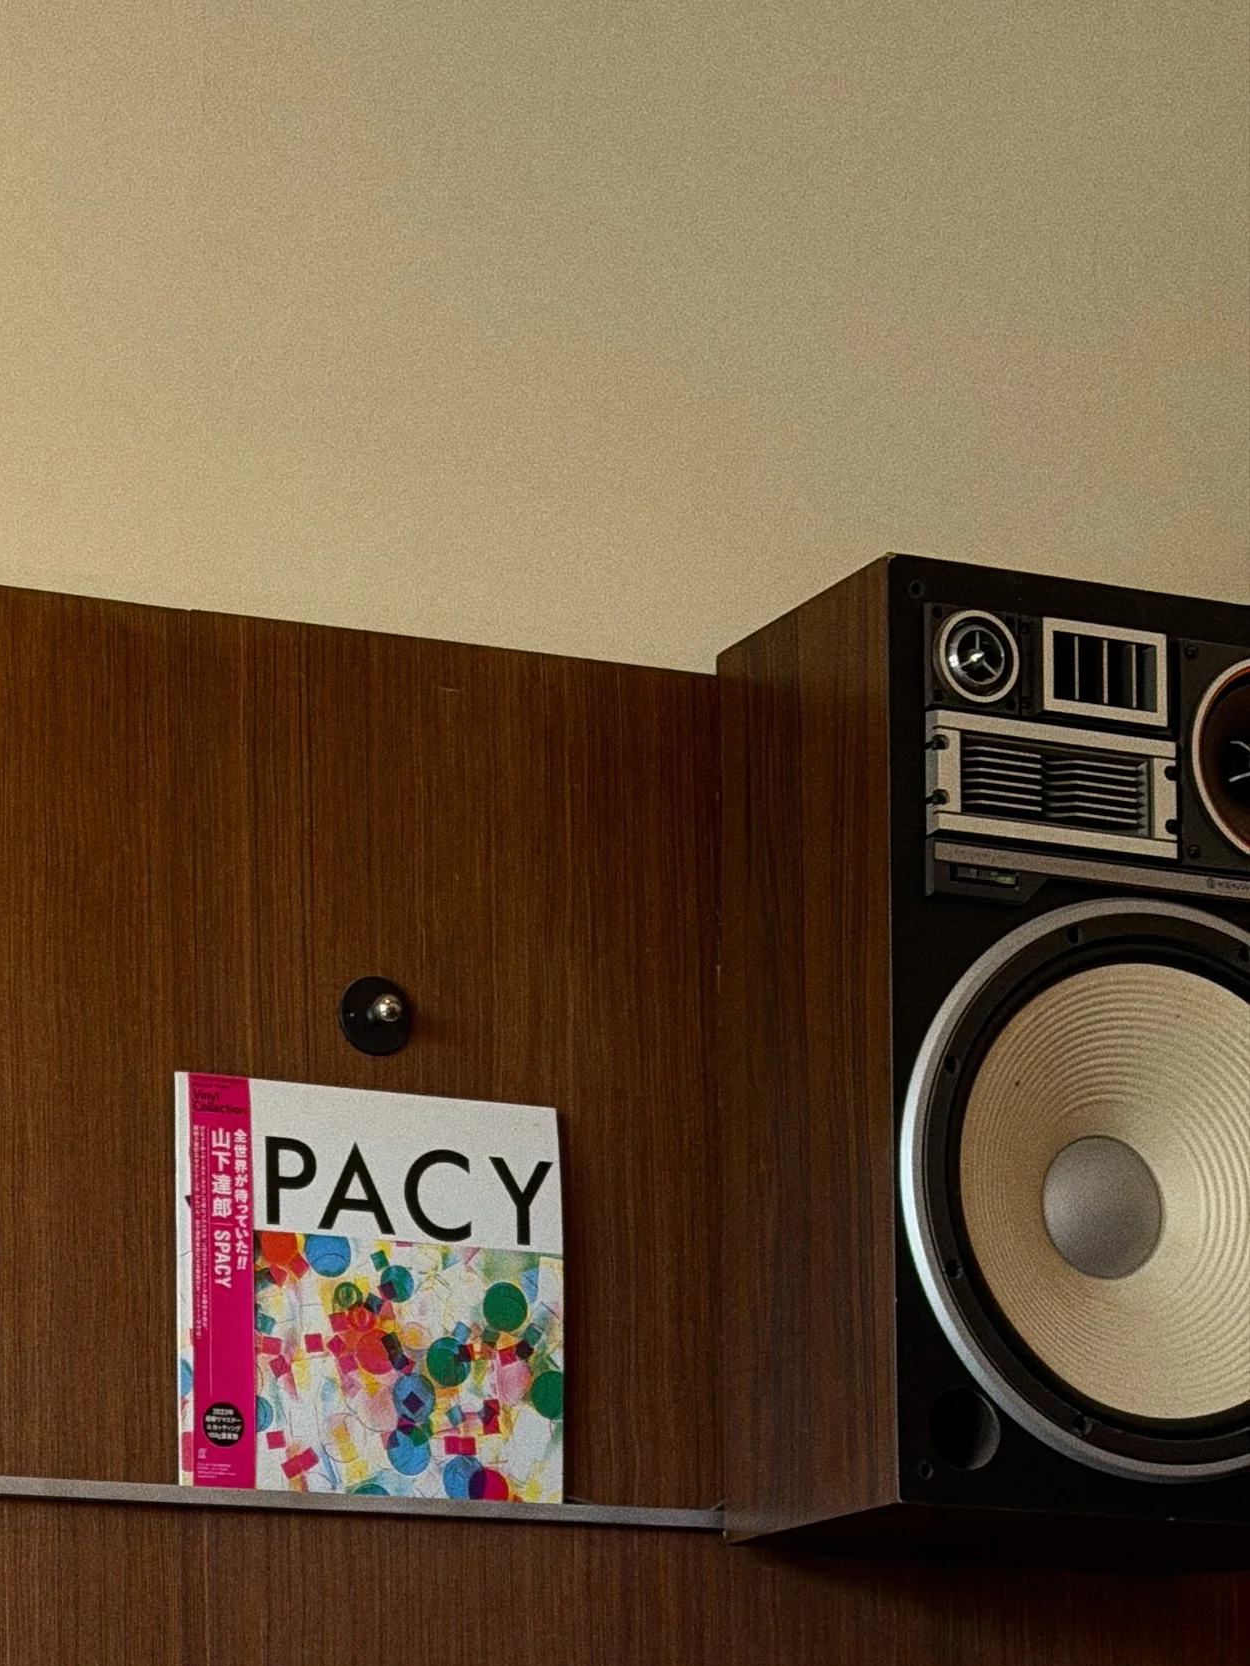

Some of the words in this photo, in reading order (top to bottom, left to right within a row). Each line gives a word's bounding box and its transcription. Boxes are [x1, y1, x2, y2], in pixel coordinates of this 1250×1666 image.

[193, 1100, 246, 1115] Collection
[211, 1127, 232, 1219] 山下達郎
[265, 1135, 553, 1246] PACY
[213, 1230, 232, 1289] SPACY
